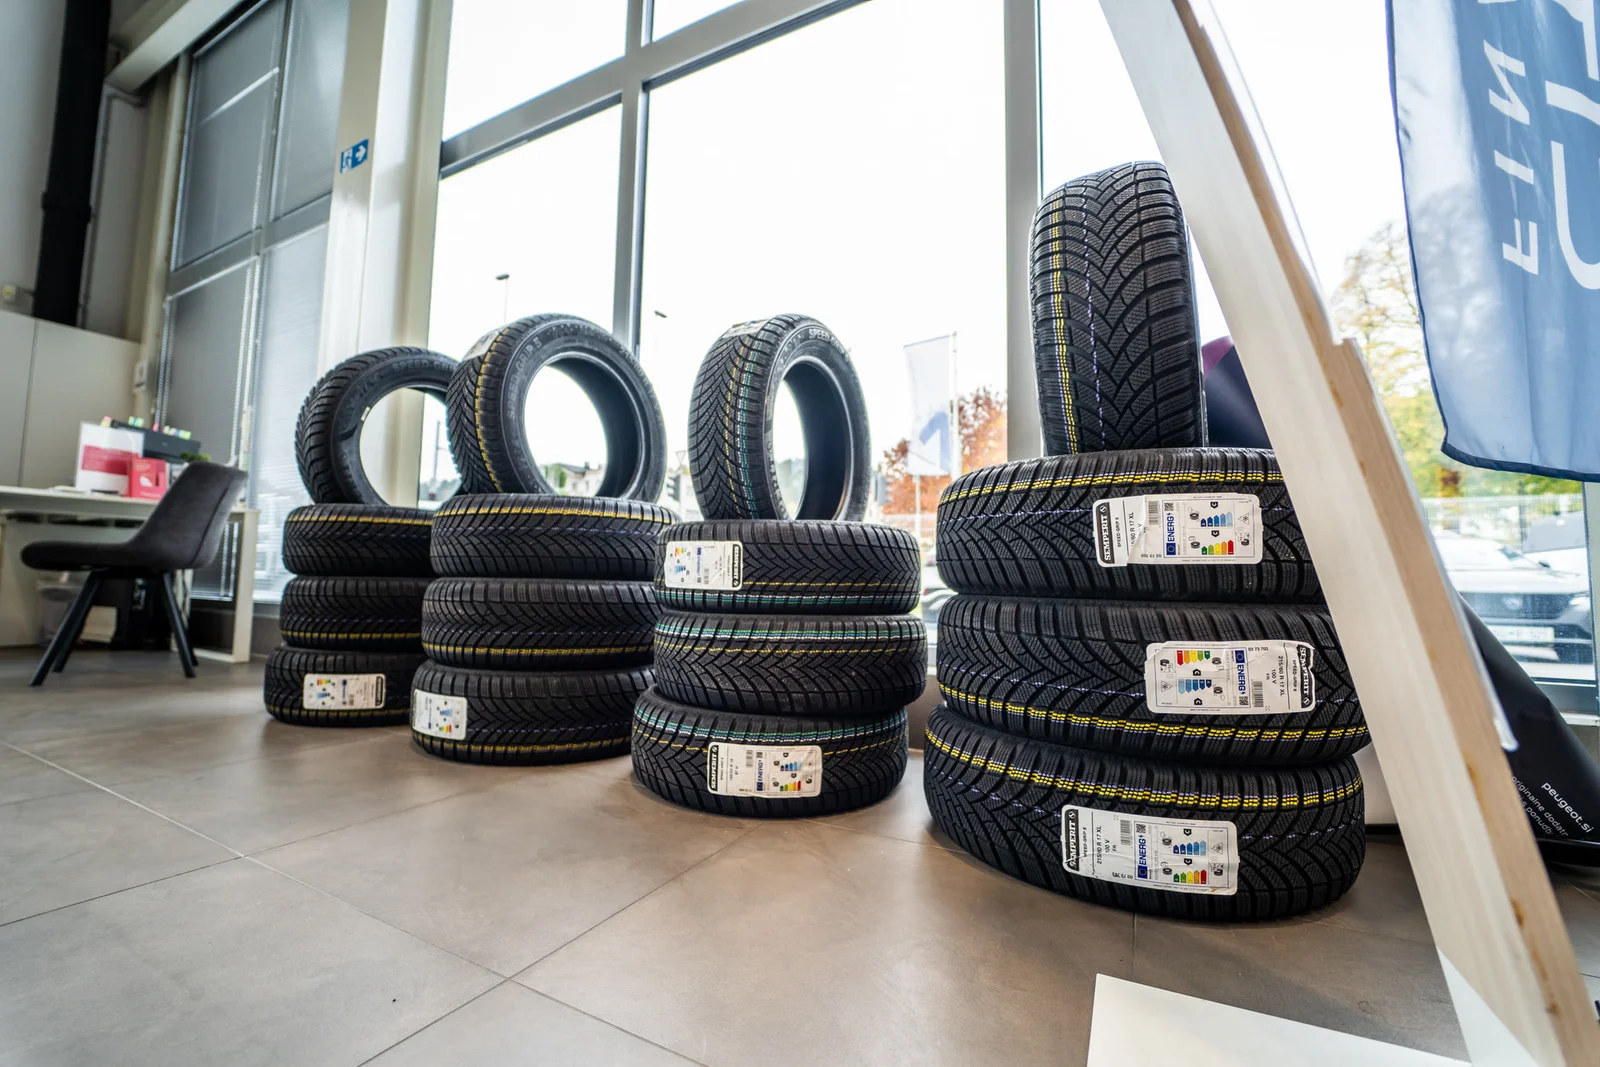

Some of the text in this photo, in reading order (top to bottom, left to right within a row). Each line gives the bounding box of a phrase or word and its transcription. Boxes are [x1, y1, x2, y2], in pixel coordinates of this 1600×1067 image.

[391, 360, 457, 372] SPEED-GRI
[507, 337, 542, 419] SPEED-GRIP 5
[1101, 515, 1111, 560] SEMPERIT
[1299, 647, 1309, 695] SEMPERIT
[1280, 689, 1285, 697] XL
[1512, 776, 1545, 812] originalne
[1541, 782, 1595, 833] peugeot.si
[1525, 807, 1553, 836] ponudb
